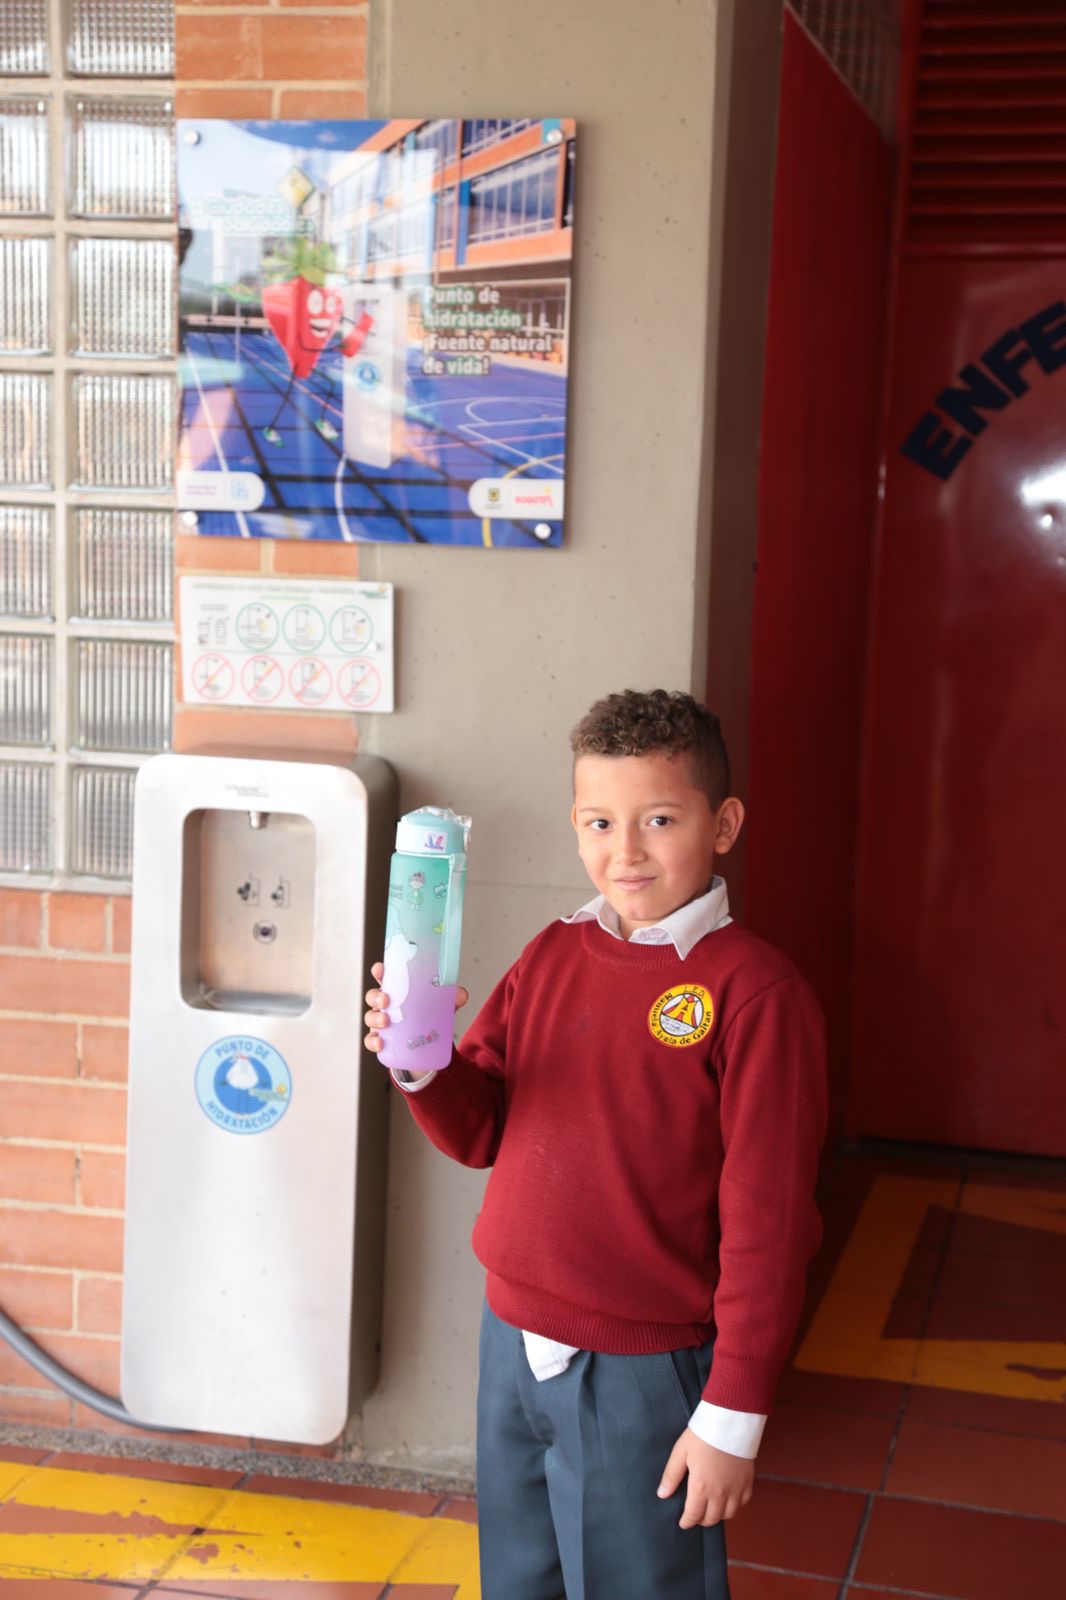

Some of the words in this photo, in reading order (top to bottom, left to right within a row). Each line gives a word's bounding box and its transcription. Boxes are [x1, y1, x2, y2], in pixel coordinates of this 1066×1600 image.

[423, 286, 475, 304] Punto
[478, 284, 499, 304] de
[424, 307, 522, 327] hidratación
[490, 334, 552, 351] natural
[422, 356, 444, 374] de
[447, 356, 490, 374] vida!
[900, 301, 1066, 480] ENFE
[215, 1040, 253, 1057] PUNTO
[255, 1044, 271, 1059] DE
[679, 1037, 691, 1045] de
